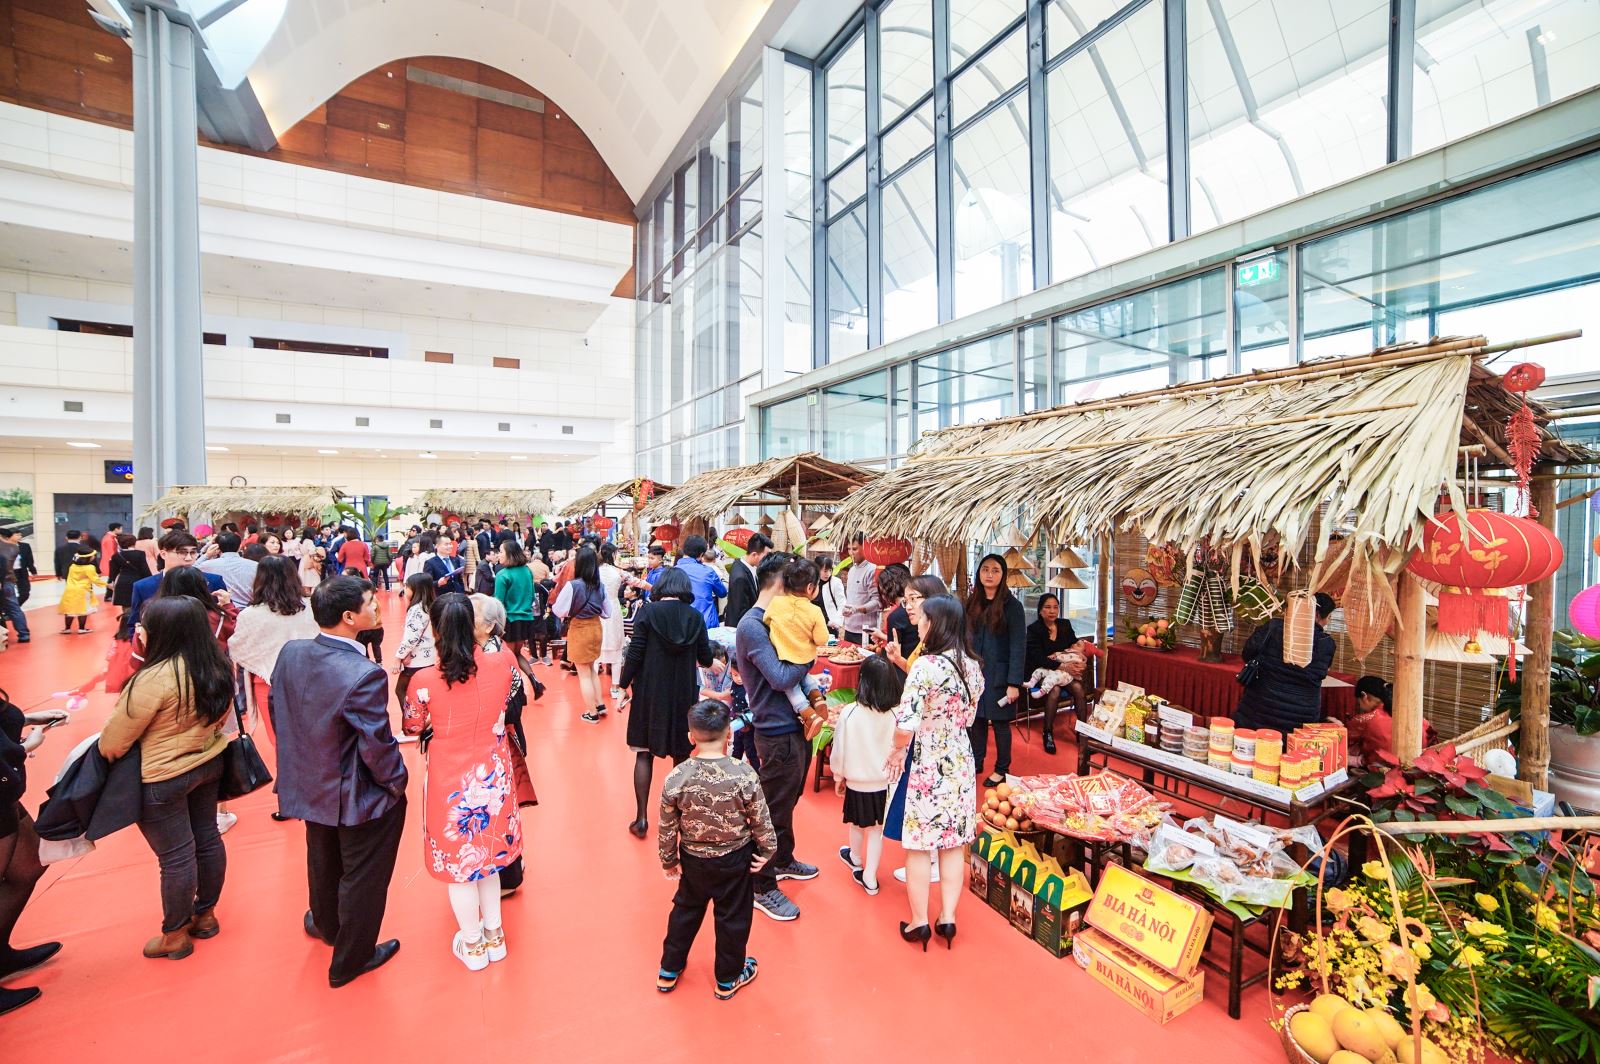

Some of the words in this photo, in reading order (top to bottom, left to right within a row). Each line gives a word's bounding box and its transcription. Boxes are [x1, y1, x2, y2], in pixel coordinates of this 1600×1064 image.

[1103, 894, 1126, 916] BIA
[1126, 905, 1147, 928] HÀ
[1148, 917, 1177, 943] NỘI
[1096, 960, 1114, 982] BIA
[1115, 973, 1132, 994] HÀ
[1133, 986, 1154, 1010] NỘI
